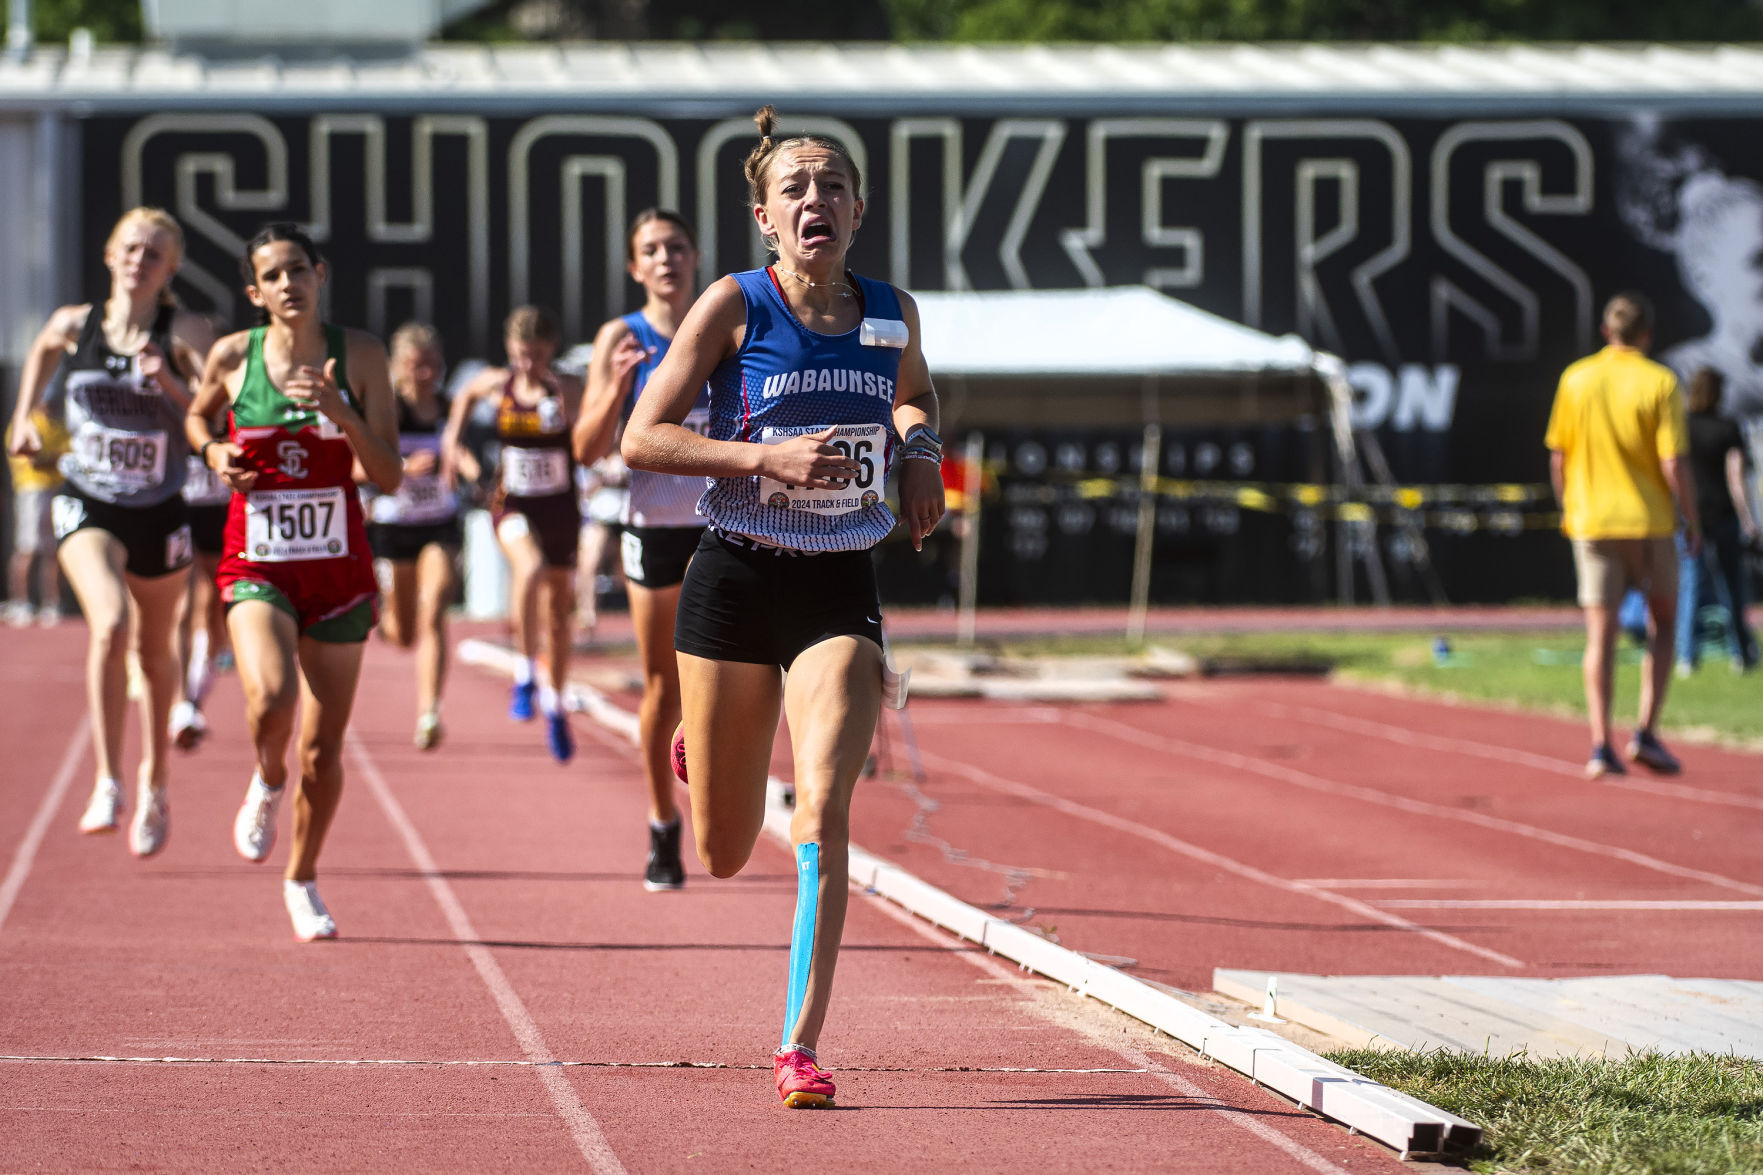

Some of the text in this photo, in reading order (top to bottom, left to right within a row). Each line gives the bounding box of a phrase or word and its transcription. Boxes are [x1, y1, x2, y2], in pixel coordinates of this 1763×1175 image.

[762, 368, 894, 402] WABAUNSEE
[772, 427, 803, 437] KSHSAA
[834, 425, 880, 437] HAMPIONSHIP
[791, 497, 860, 509] 2024 TRACK & FIELD
[261, 501, 335, 541] 1507
